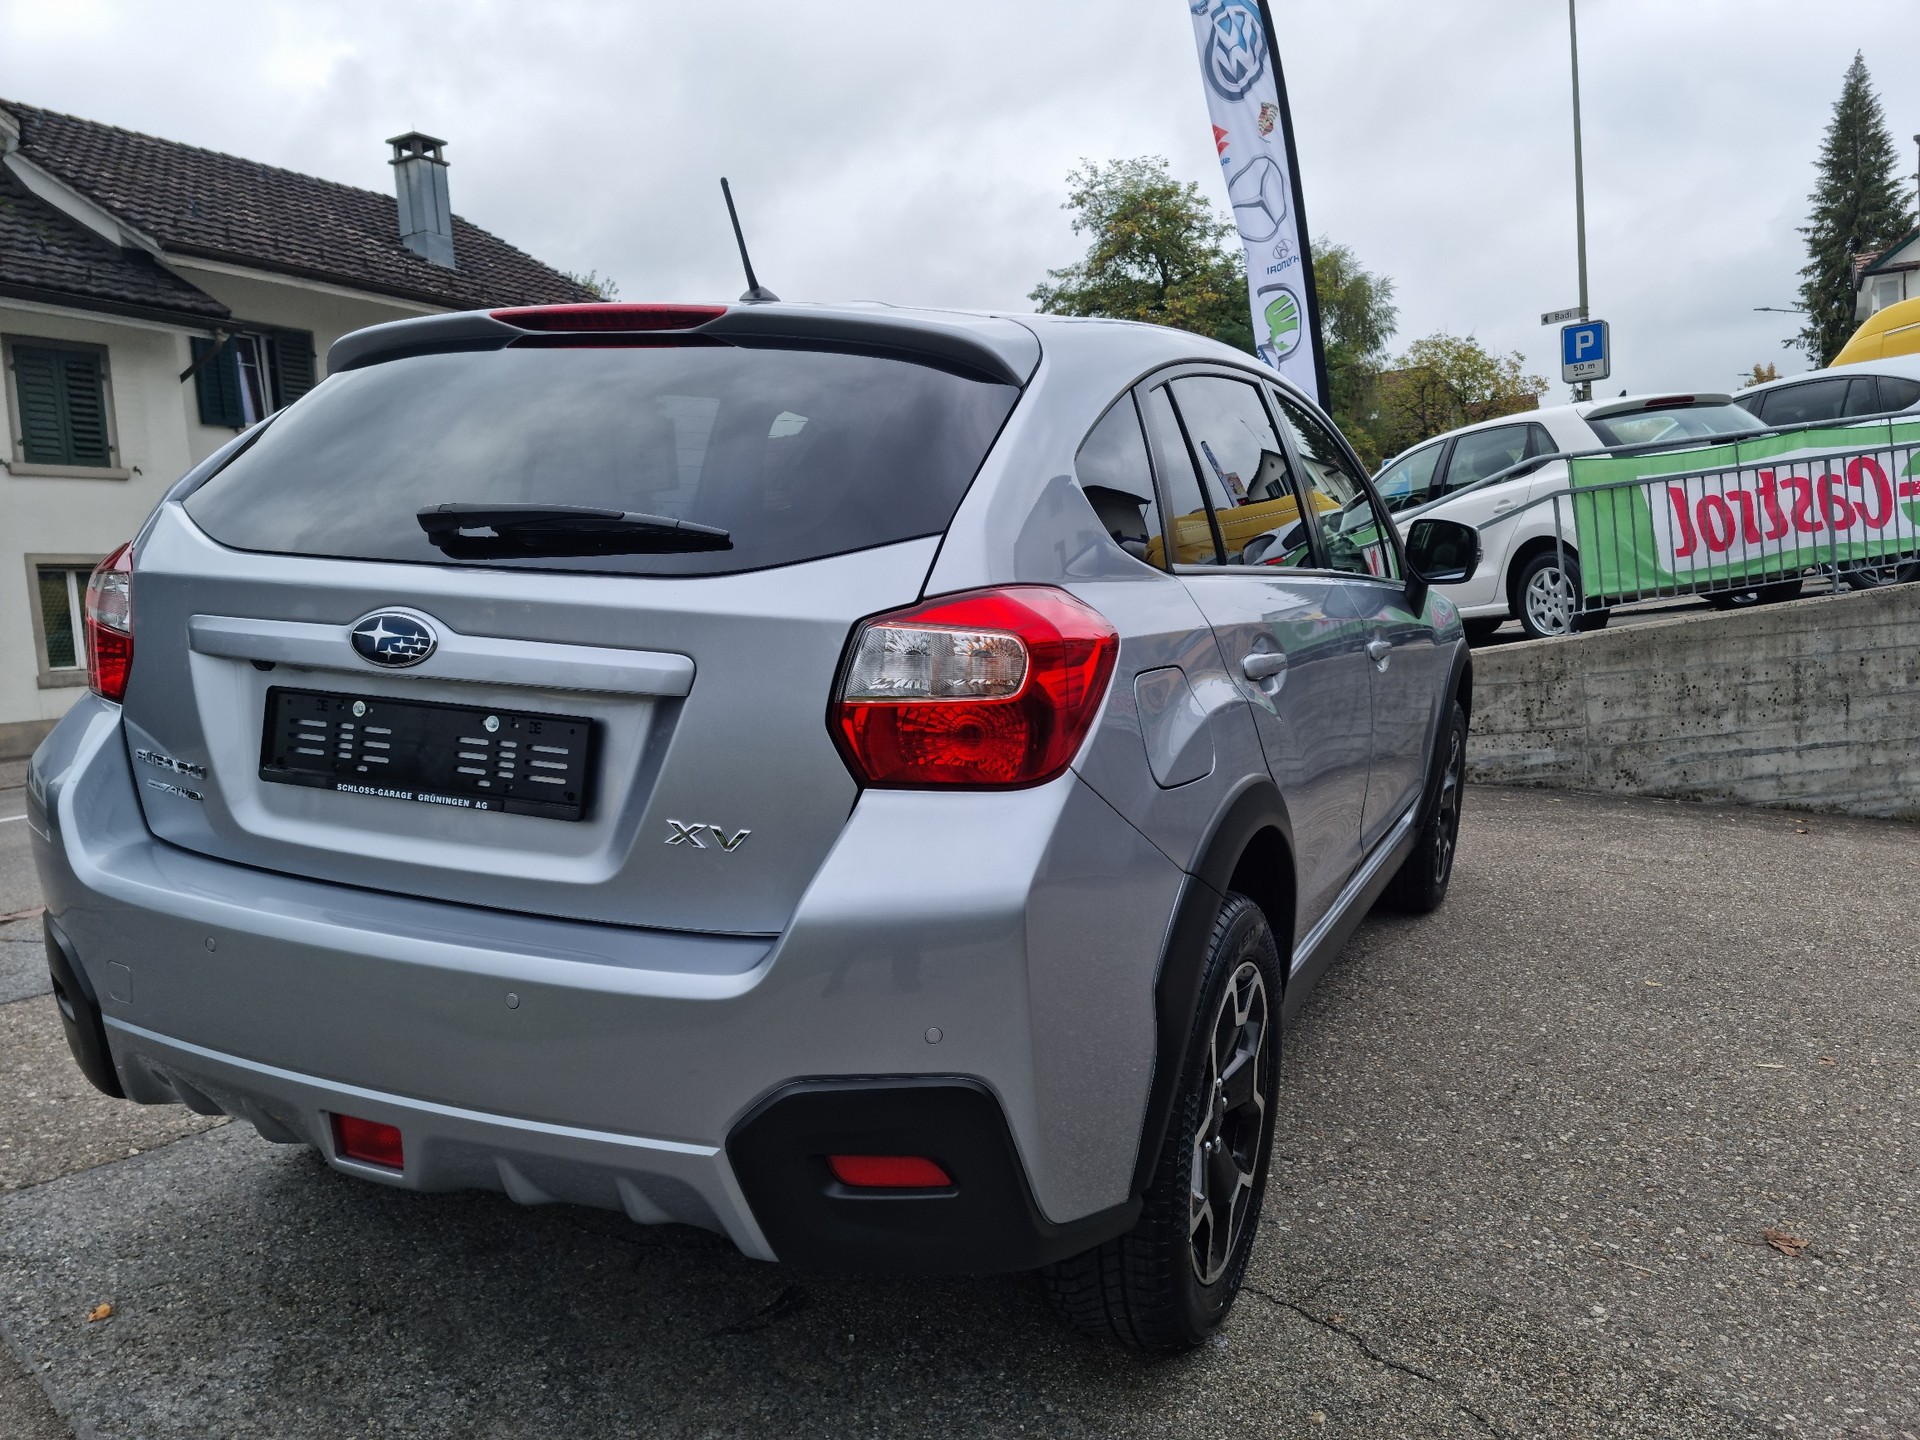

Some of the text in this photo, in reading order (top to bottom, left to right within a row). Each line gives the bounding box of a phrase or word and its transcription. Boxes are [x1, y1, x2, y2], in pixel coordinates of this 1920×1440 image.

[1554, 311, 1572, 321] Badi
[1575, 330, 1595, 359] P
[1573, 363, 1585, 372] 50
[337, 783, 488, 809] SCHLOSS-GARAGE GRÜNINGEN AG
[664, 819, 752, 852] XV
